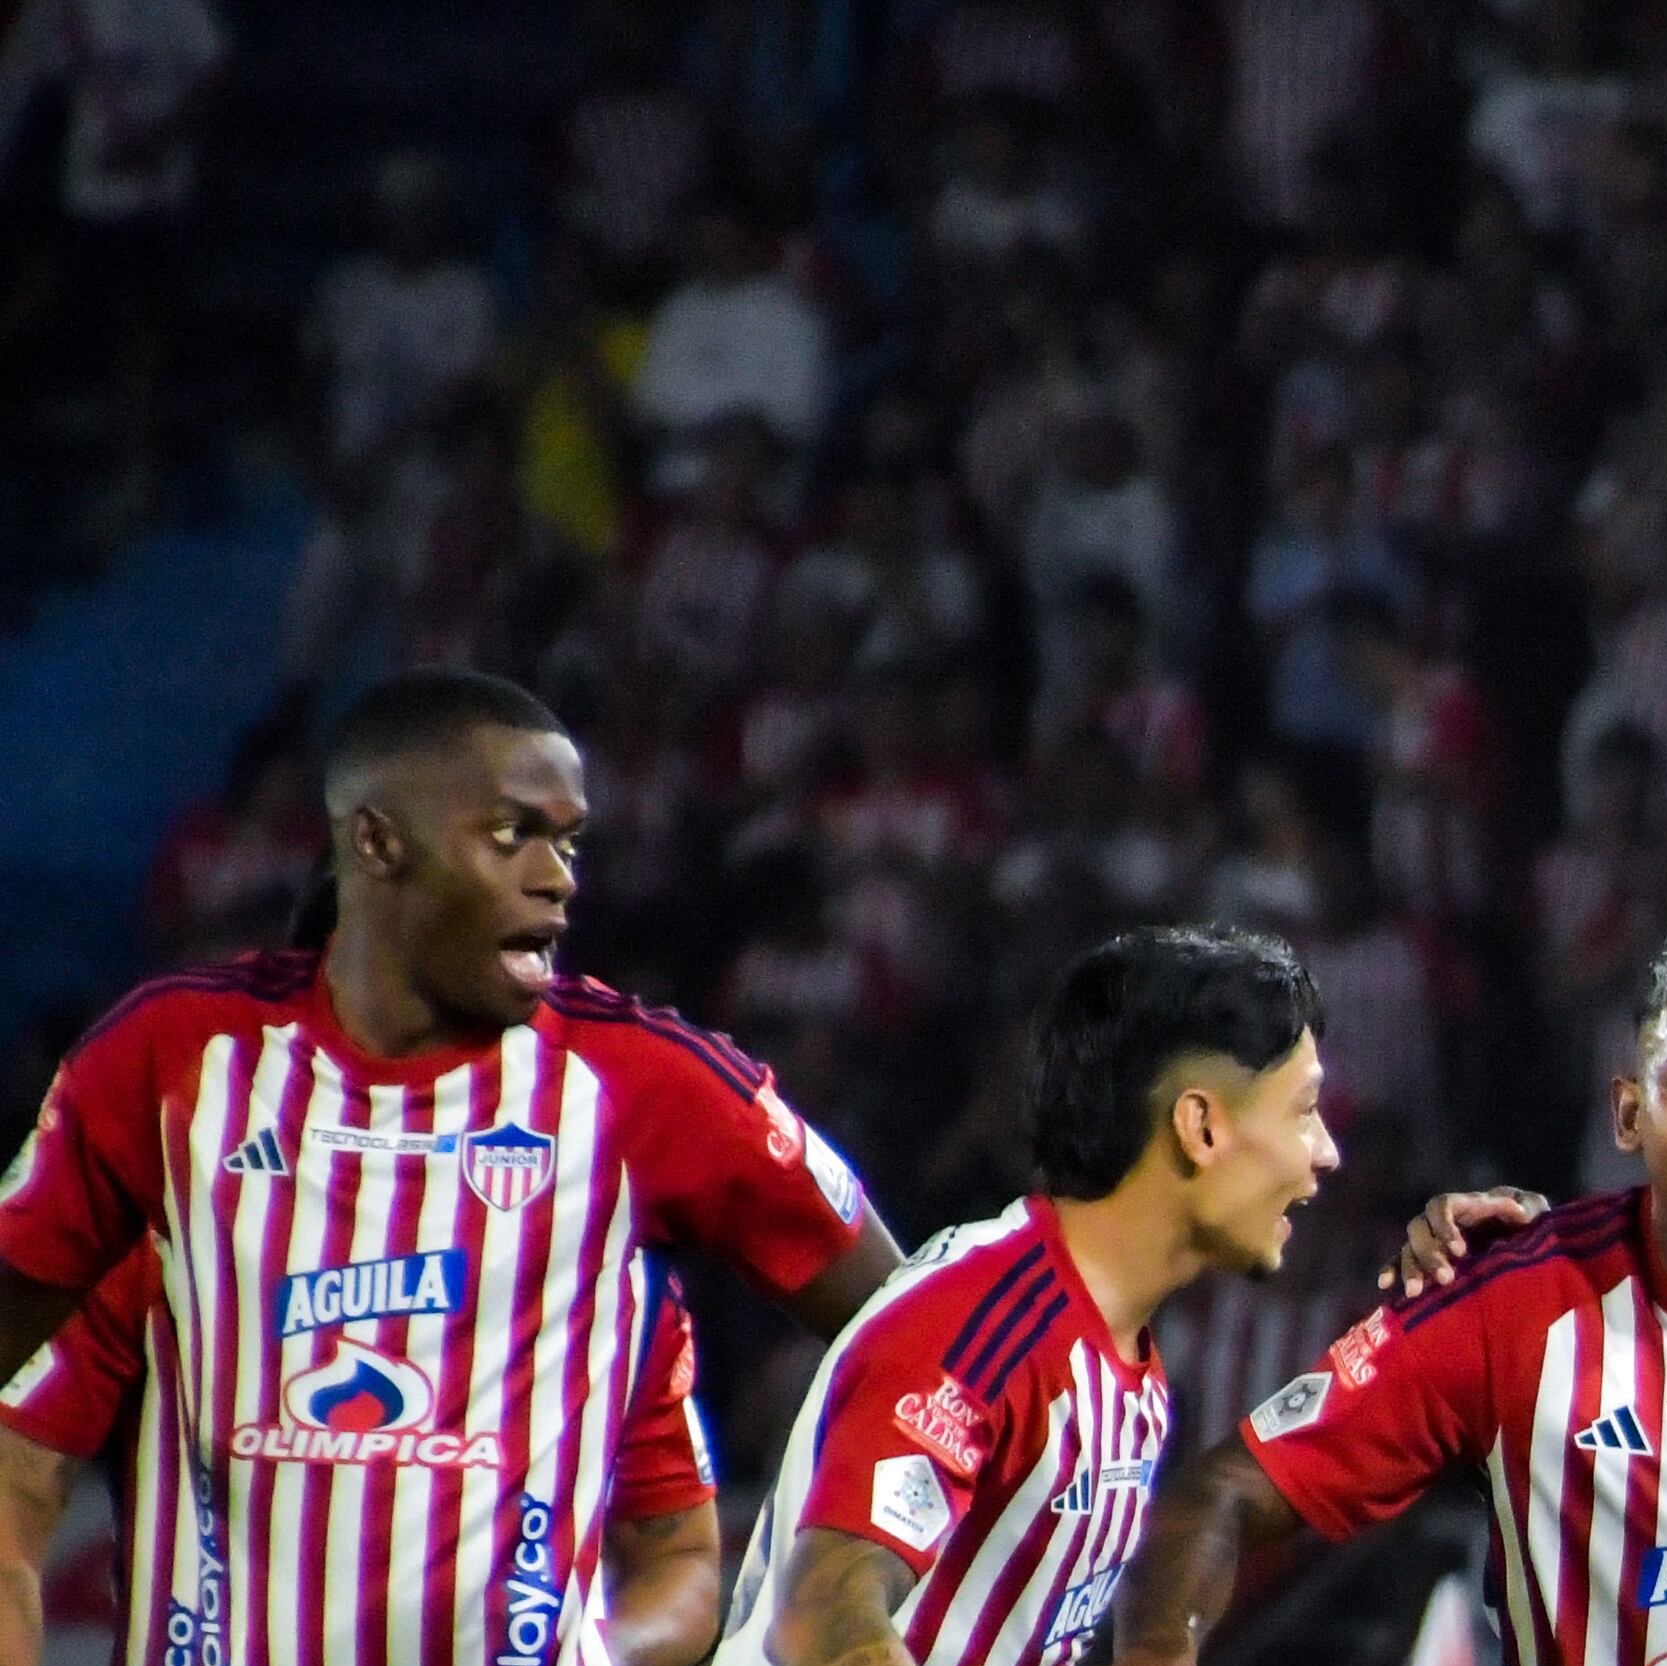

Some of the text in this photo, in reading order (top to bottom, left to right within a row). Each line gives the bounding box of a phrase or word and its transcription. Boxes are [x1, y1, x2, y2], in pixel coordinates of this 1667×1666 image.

[478, 1151, 540, 1167] JUNIOR
[282, 1253, 450, 1335] AGUILA
[231, 1427, 500, 1466] OLIMPICA
